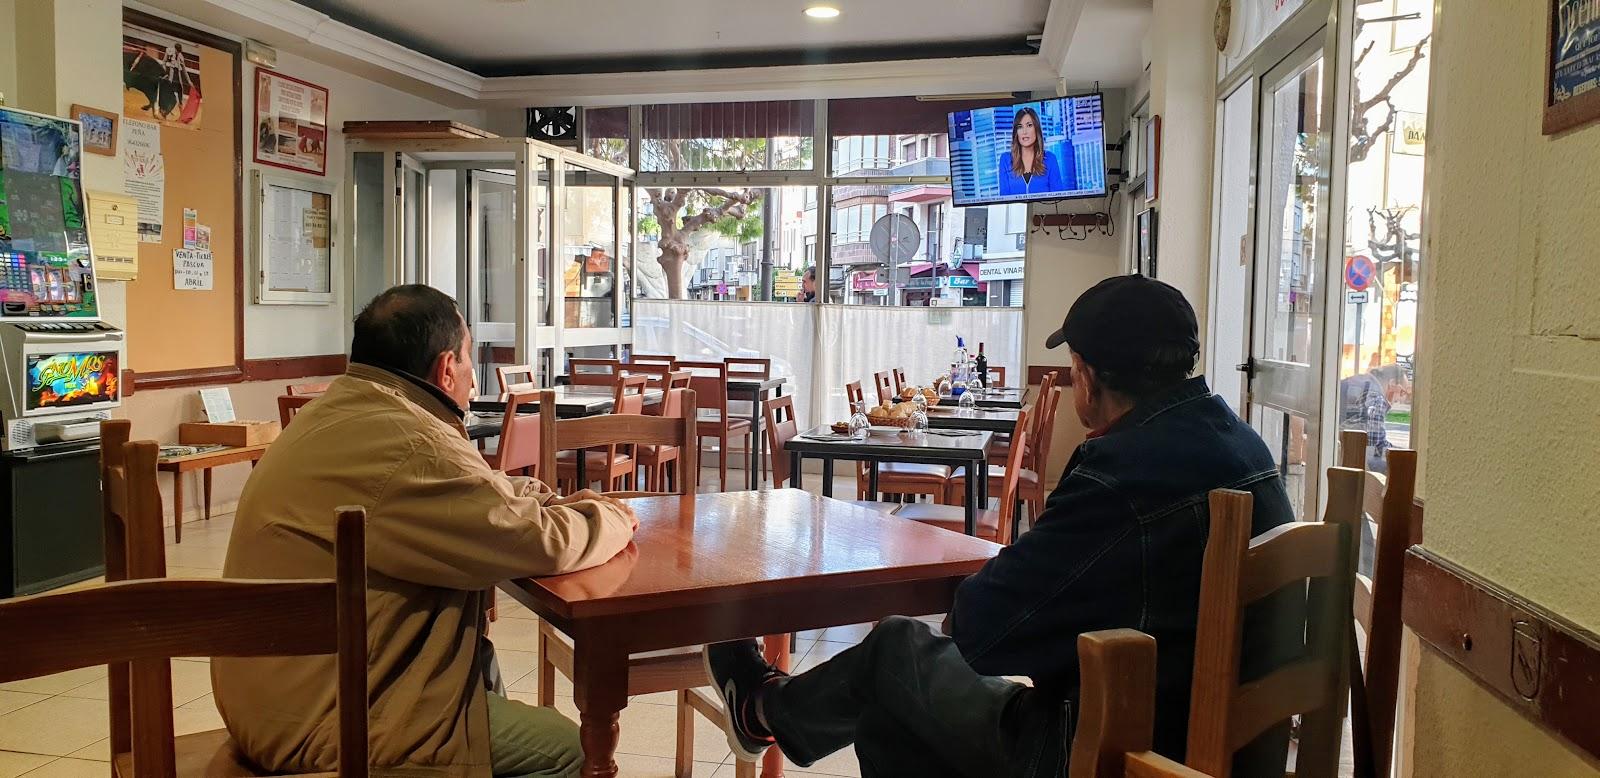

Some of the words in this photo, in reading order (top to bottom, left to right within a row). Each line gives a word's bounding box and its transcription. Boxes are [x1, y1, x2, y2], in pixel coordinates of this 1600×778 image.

[980, 268, 1002, 276] DENTAL
[1003, 267, 1024, 275] VINAR
[184, 278, 203, 286] ABRIL
[953, 277, 969, 285] Bar
